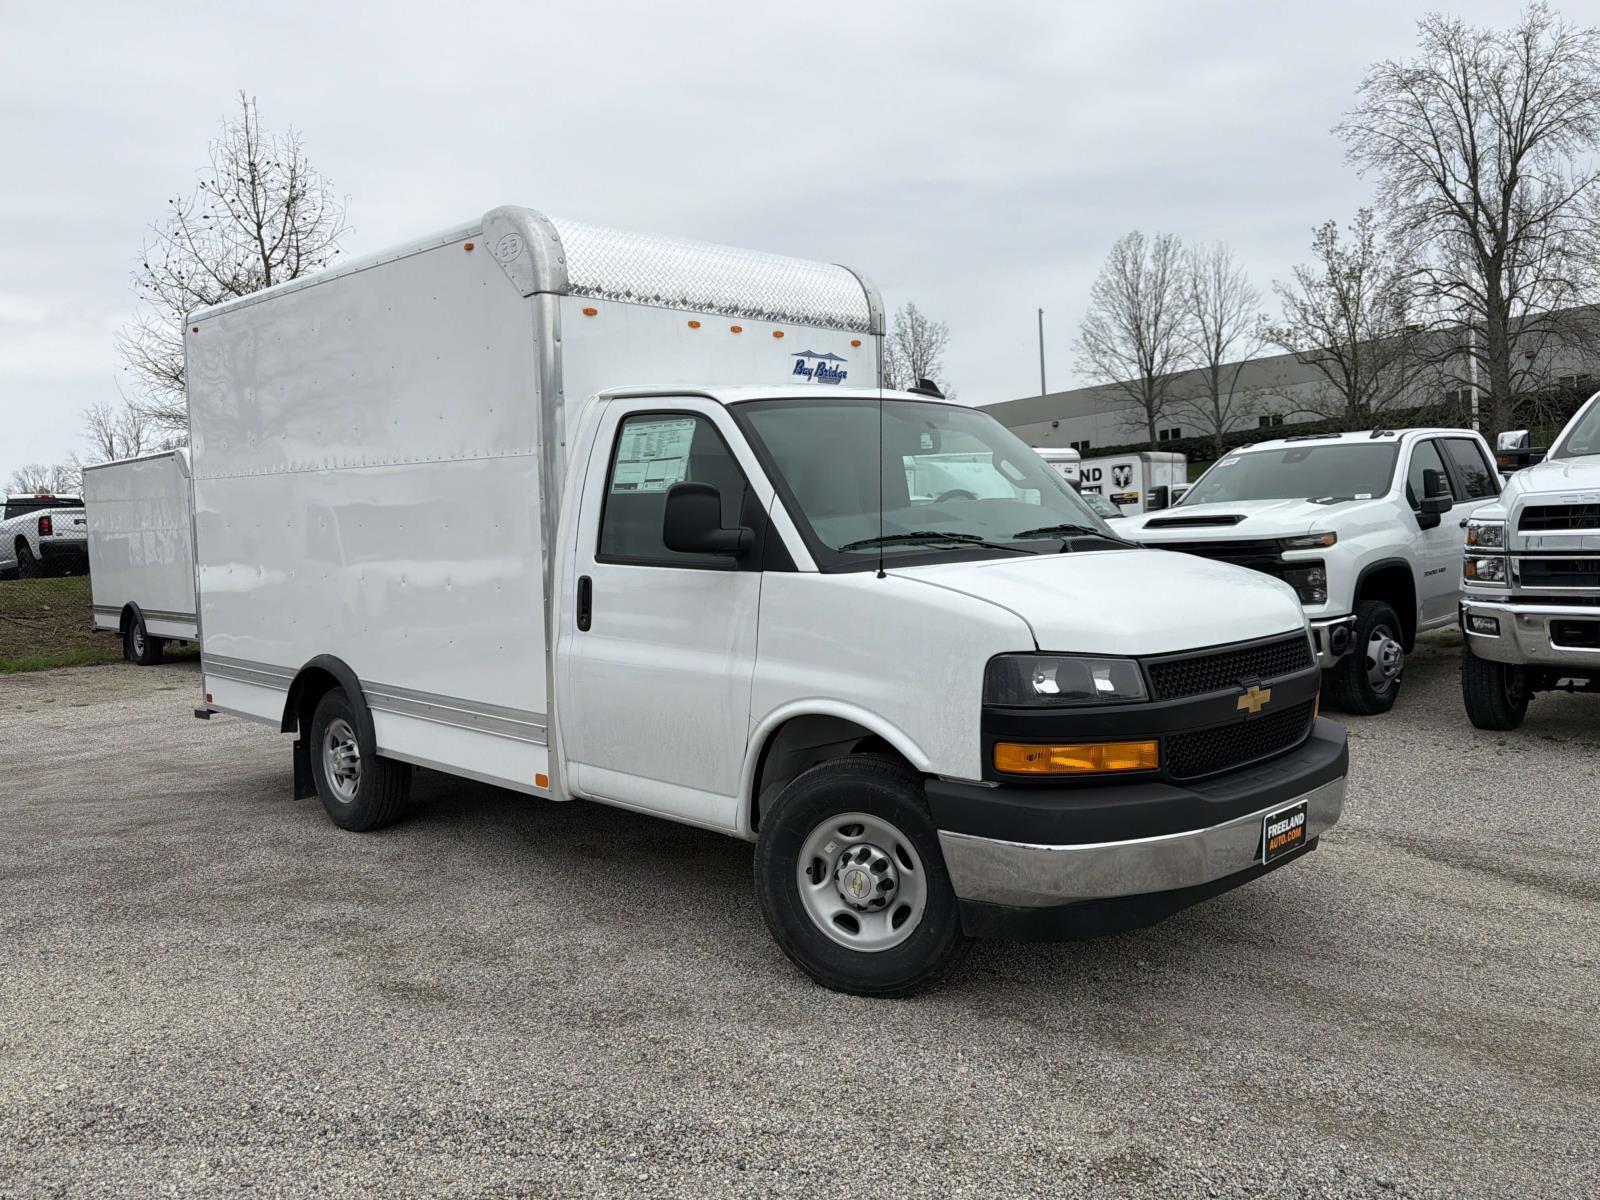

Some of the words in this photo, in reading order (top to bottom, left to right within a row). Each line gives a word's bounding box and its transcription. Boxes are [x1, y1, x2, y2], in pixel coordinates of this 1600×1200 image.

[792, 359, 814, 381] Bay
[813, 361, 848, 384] Bridge
[1267, 812, 1305, 839] FREELAND
[1268, 826, 1303, 852] AUTO.COM
